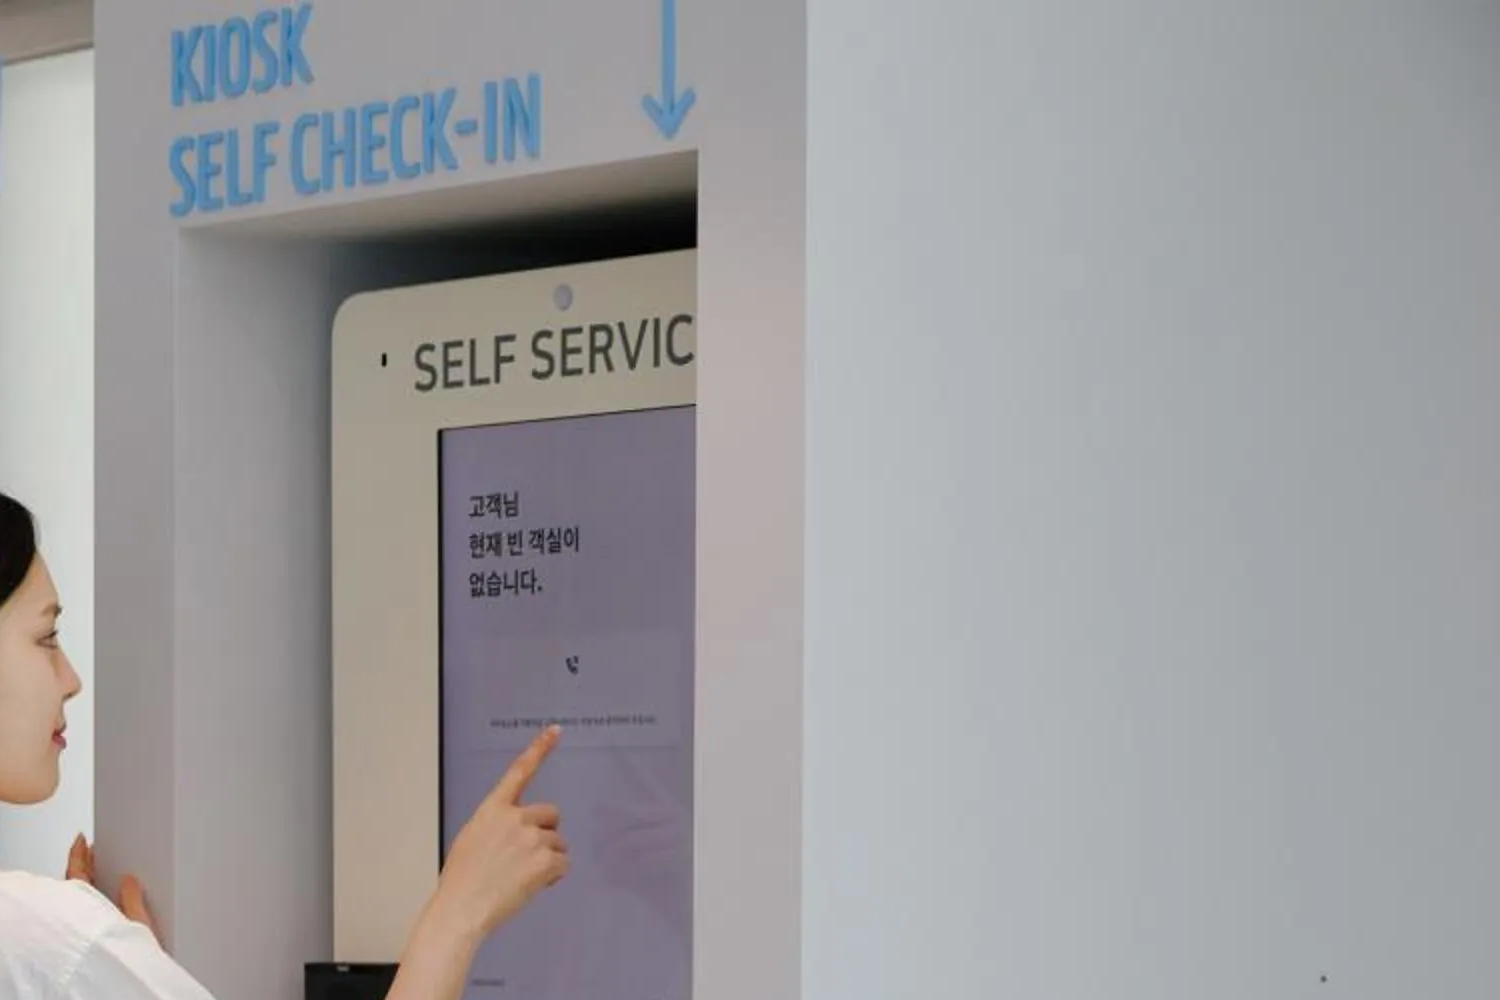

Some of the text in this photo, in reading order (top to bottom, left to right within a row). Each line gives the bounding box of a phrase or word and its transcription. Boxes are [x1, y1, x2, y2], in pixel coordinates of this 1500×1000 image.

[169, 2, 314, 107] KIOSK
[168, 71, 542, 218] SELF CHECK-IN
[413, 332, 518, 394] SELF
[468, 490, 519, 519] 고객님
[468, 525, 580, 559] 현재 빈 객실이
[467, 567, 543, 598] 없습니다.
